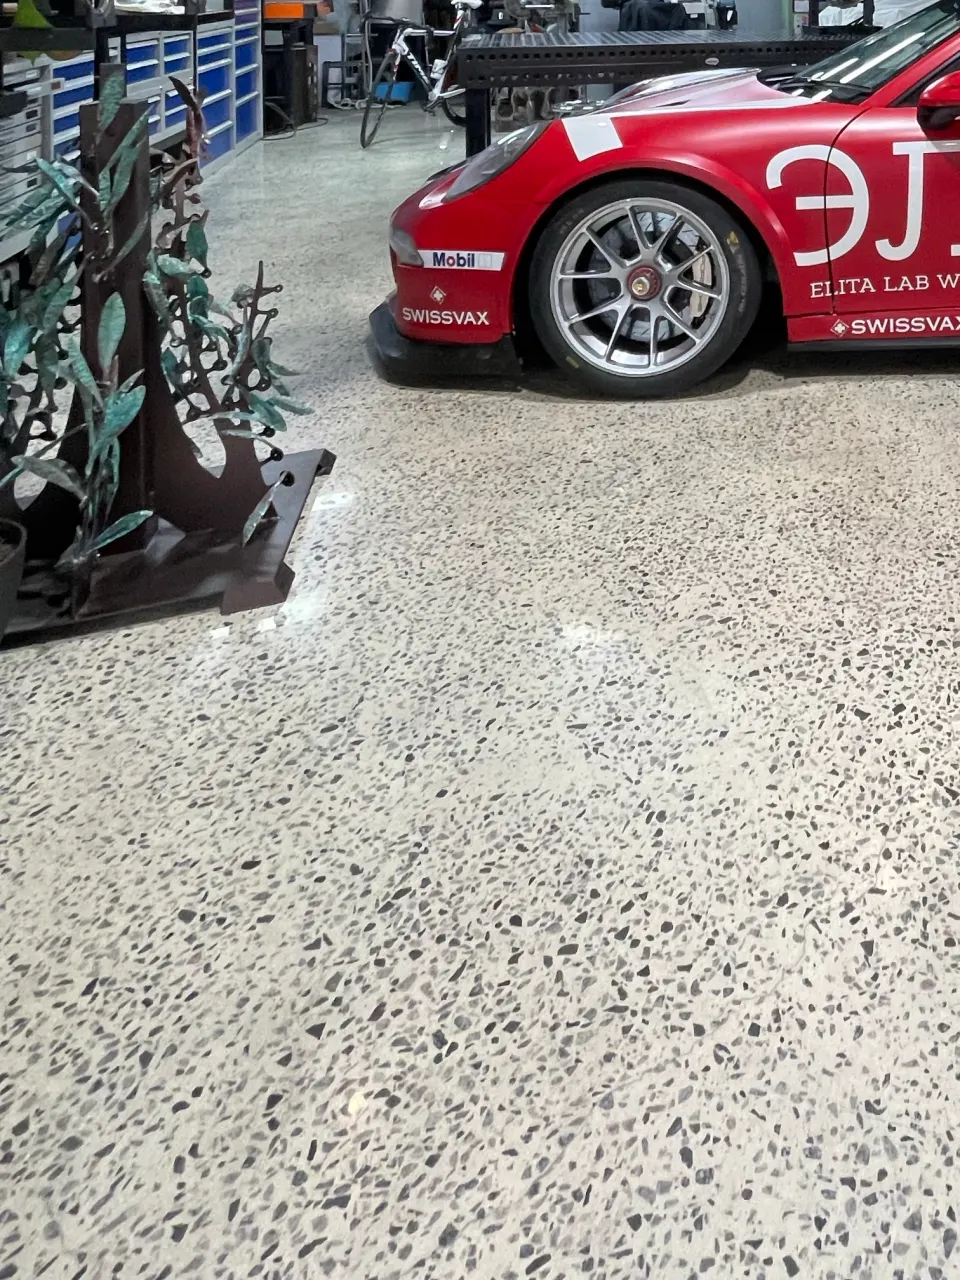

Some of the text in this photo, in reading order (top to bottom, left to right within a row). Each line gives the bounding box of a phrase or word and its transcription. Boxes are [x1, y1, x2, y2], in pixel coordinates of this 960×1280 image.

[432, 251, 475, 268] Mobil
[809, 277, 876, 299] ELITA
[883, 275, 929, 292] LAB
[402, 307, 489, 326] SWISSVAX
